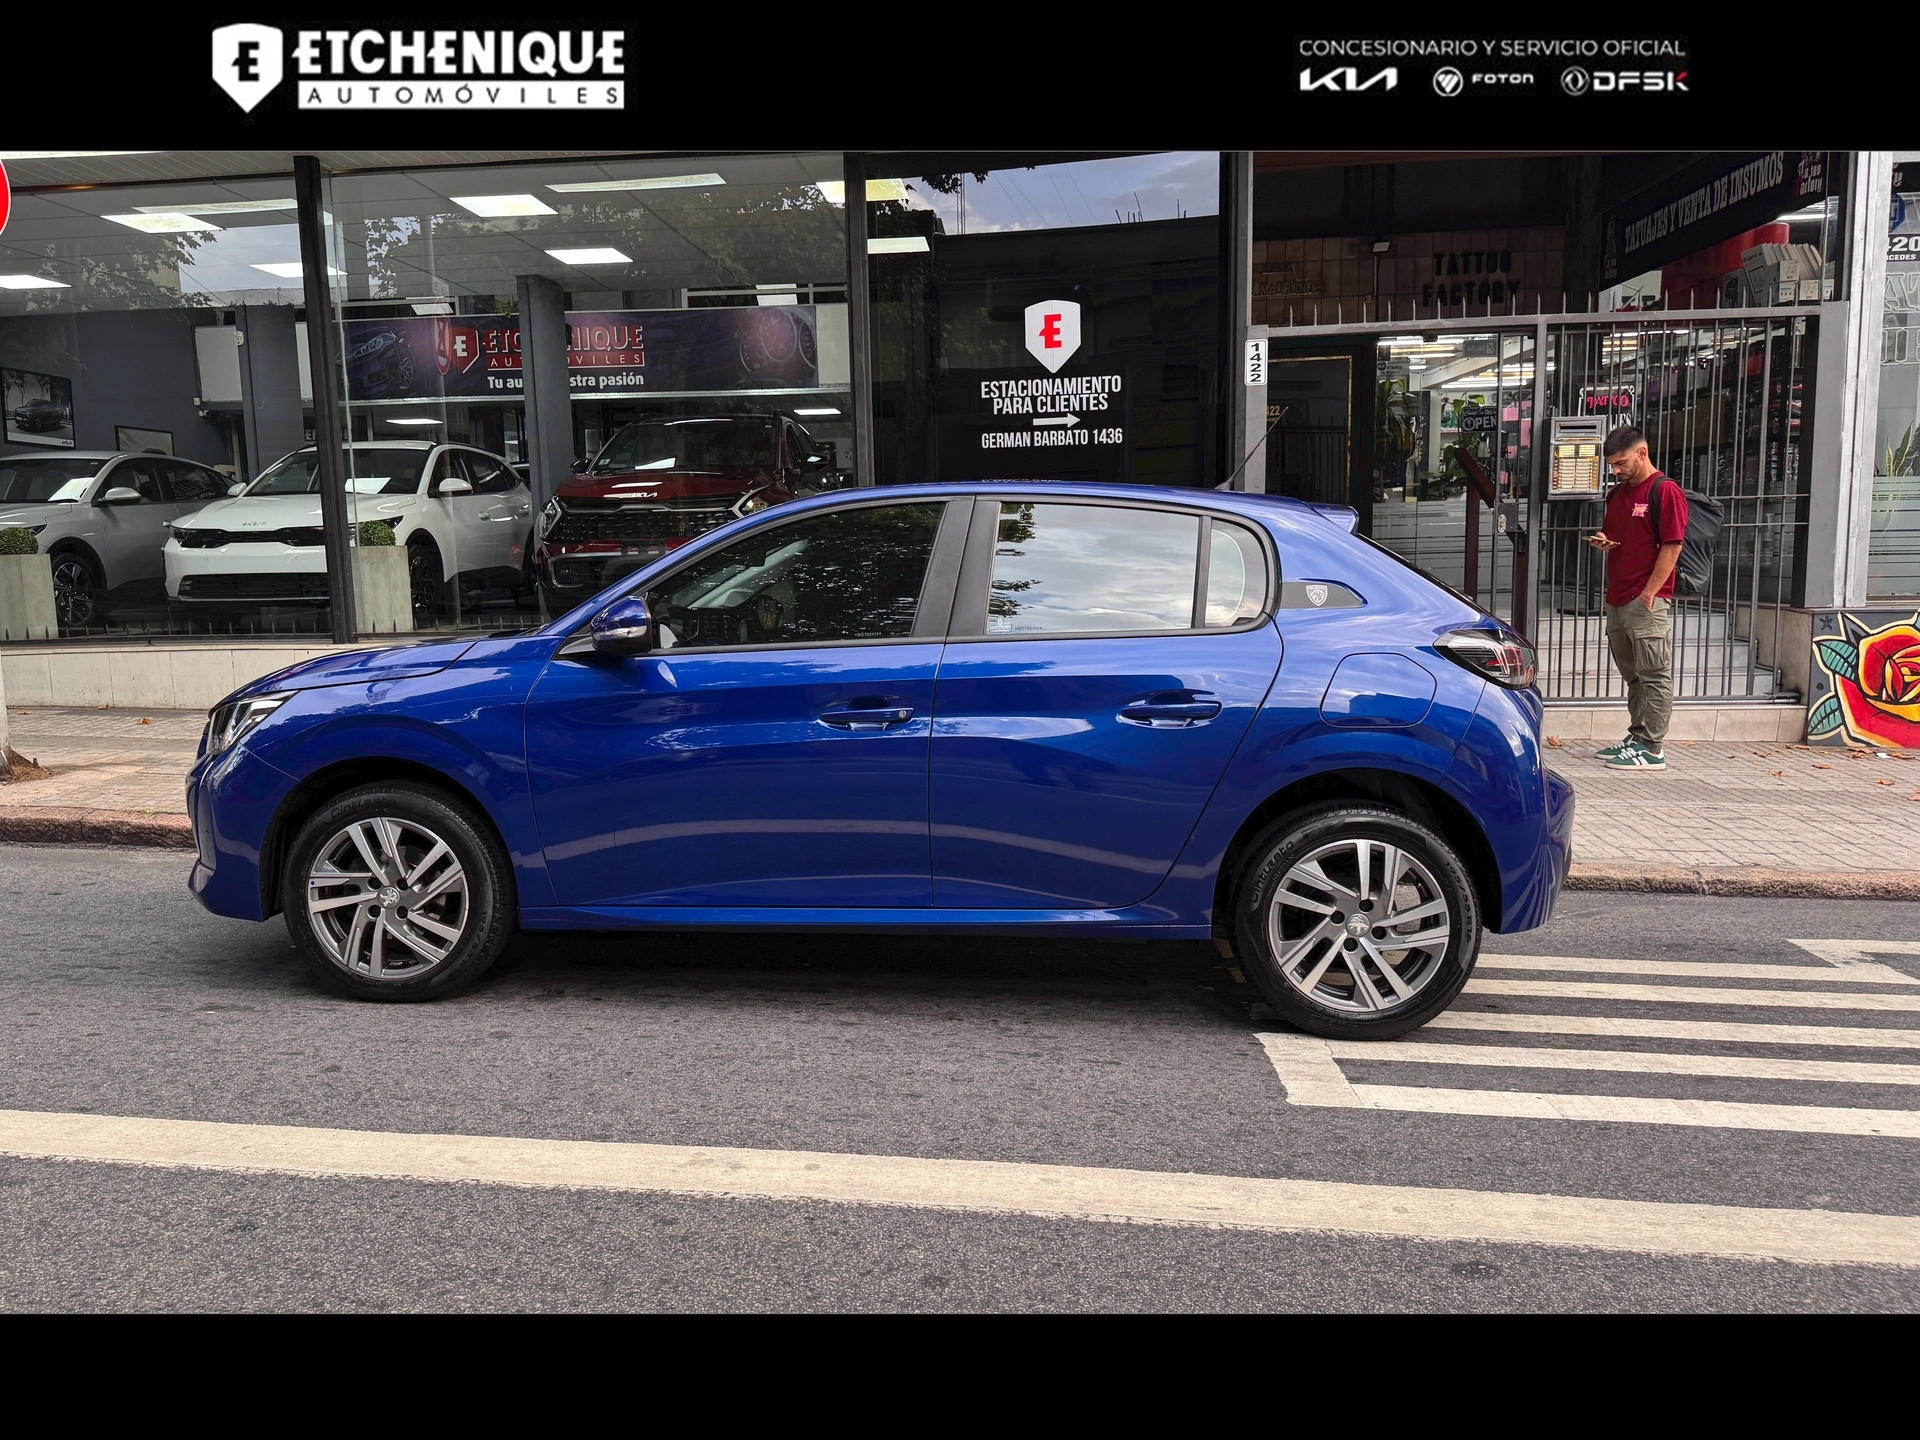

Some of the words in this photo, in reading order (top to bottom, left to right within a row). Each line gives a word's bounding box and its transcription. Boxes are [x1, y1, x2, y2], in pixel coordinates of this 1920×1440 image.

[1625, 206, 1669, 254] TATUAJES
[1669, 202, 1678, 233] Y
[1678, 188, 1713, 229] VENTA
[1713, 177, 1729, 213] DE
[1728, 152, 1784, 206] INSUMOS
[1433, 250, 1512, 276] TATTOO
[1422, 280, 1520, 308] FACTORY
[1250, 342, 1262, 383] 1422
[487, 376, 503, 389] Tu
[599, 372, 645, 389] pasión
[981, 375, 1122, 399] ESTACIONAMIENTO
[993, 397, 1033, 415] PARA
[1037, 393, 1108, 413] CLIENTES
[1462, 415, 1497, 431] OPEN
[981, 432, 1031, 449] GERMAN
[1034, 429, 1089, 447] BARBATO
[1092, 428, 1123, 444] 1436
